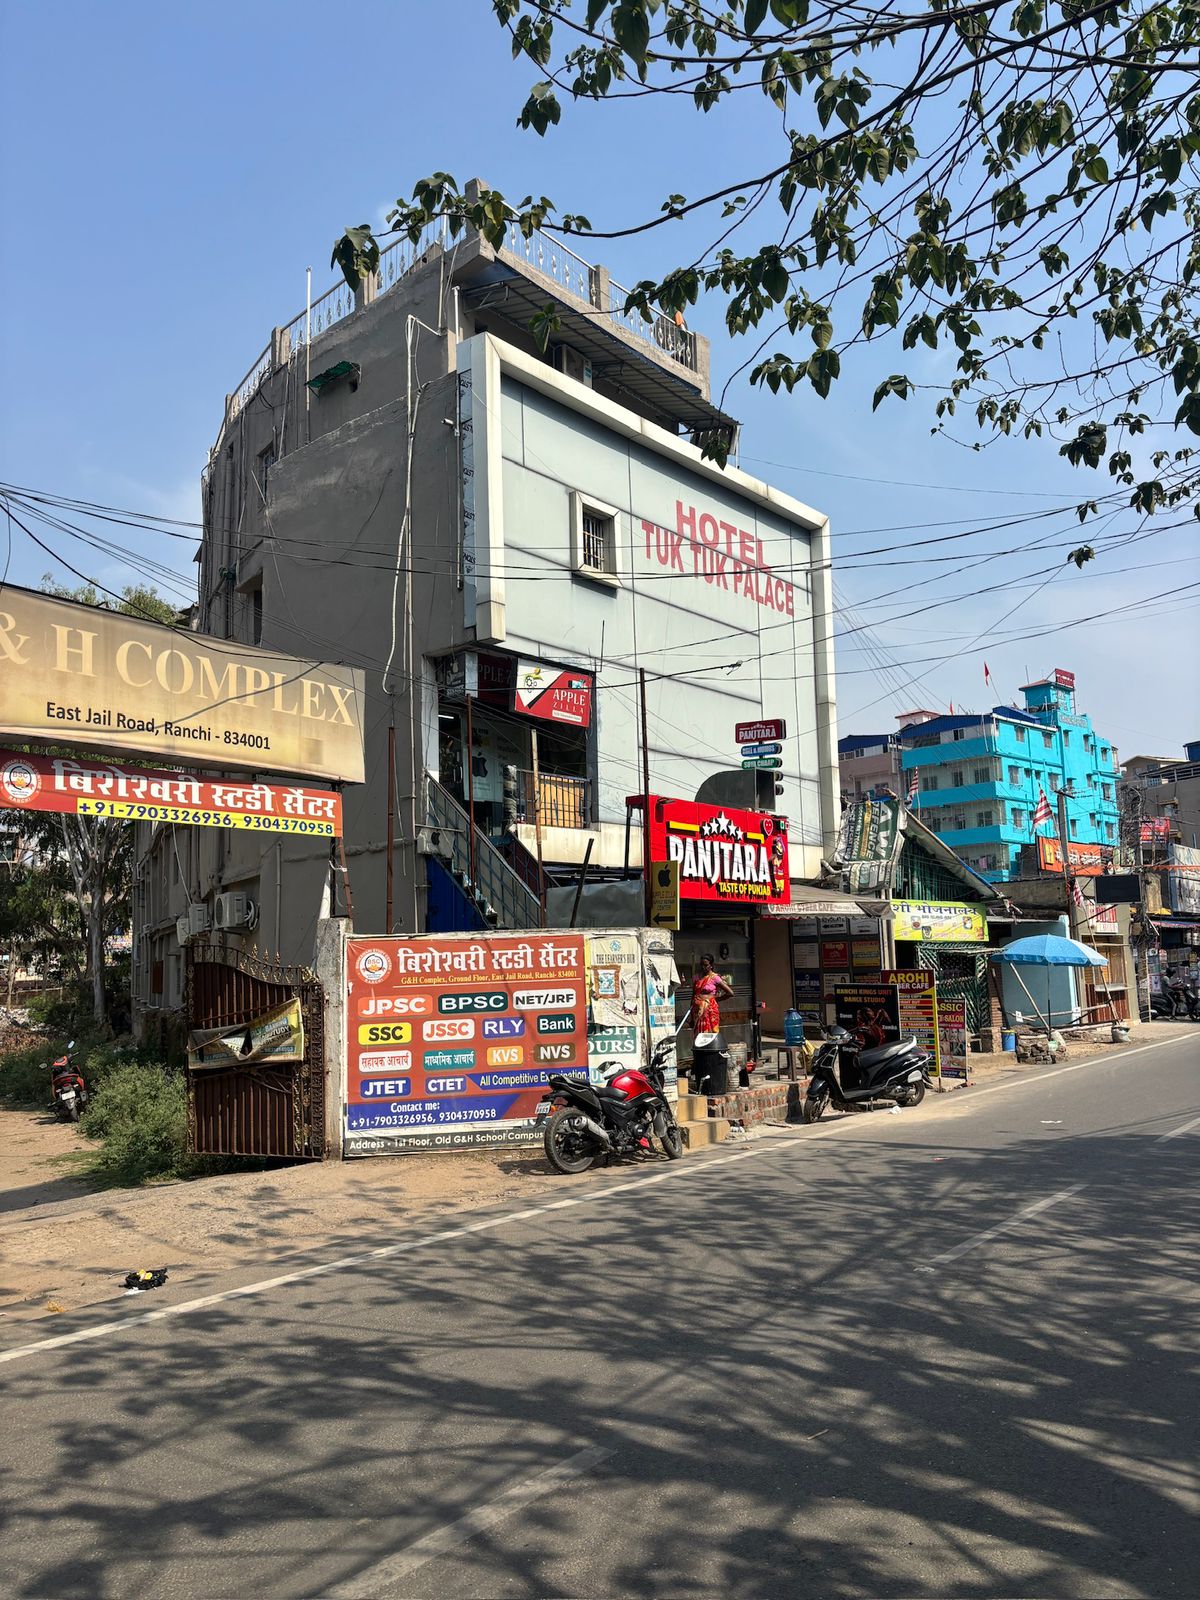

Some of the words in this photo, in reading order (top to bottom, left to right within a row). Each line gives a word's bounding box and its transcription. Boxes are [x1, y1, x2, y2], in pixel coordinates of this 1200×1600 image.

[676, 500, 772, 574] HOTEL
[641, 519, 684, 572] TUK
[690, 540, 728, 591] TUK
[733, 559, 794, 617] PALACE
[0, 611, 30, 664] &
[51, 624, 98, 677] H
[116, 640, 355, 727] COMPLEX
[553, 689, 586, 706] APPLE
[553, 701, 584, 714] ZILLA
[46, 701, 81, 723] East
[85, 707, 112, 728] Jail
[116, 712, 160, 736] Road,
[164, 721, 211, 742] Ranchi
[223, 731, 271, 750] 834001
[739, 728, 776, 740] PANJTARA
[13, 771, 28, 779] BSC
[211, 784, 276, 812] स्टडी
[244, 815, 333, 835] 9304370958
[669, 836, 771, 884] PANJTARA
[719, 882, 739, 893] TASTE
[740, 883, 747, 893] OF
[748, 884, 771, 896] PUNJAB
[915, 902, 977, 914] भोजनालय
[491, 944, 534, 970] स्टडी
[401, 977, 418, 985] G&H
[448, 974, 472, 983] Ground
[505, 972, 516, 980] Jail
[558, 970, 577, 978] 834001
[888, 973, 929, 983] AROHI
[361, 997, 426, 1015] JPSC
[441, 995, 504, 1010] BPSC
[515, 993, 574, 1005] NET/JRF
[426, 1022, 469, 1038] JSSC
[484, 1019, 523, 1034] RLY
[539, 1017, 573, 1030] Bank
[368, 1026, 403, 1041] SSC
[453, 1051, 474, 1064] आचार्य
[492, 1048, 518, 1063] KVS
[540, 1045, 570, 1059] NVS
[361, 1056, 385, 1069] सहायक
[387, 1052, 409, 1066] आचार्य
[428, 1078, 464, 1092] CTET
[480, 1075, 491, 1086] All
[492, 1071, 538, 1087] Competitive
[364, 1080, 406, 1095] JTET
[391, 1102, 422, 1113] Contact
[425, 1102, 440, 1111] me:
[351, 1113, 436, 1128] +91-7903326956,
[439, 1109, 497, 1121] 9304370958
[349, 1140, 385, 1150] Address
[394, 1138, 406, 1147] 1st
[408, 1137, 432, 1147] Floor,
[435, 1136, 451, 1144] Old
[453, 1134, 473, 1143] G&H
[476, 1132, 505, 1142] School
[508, 1131, 545, 1142] Campus
